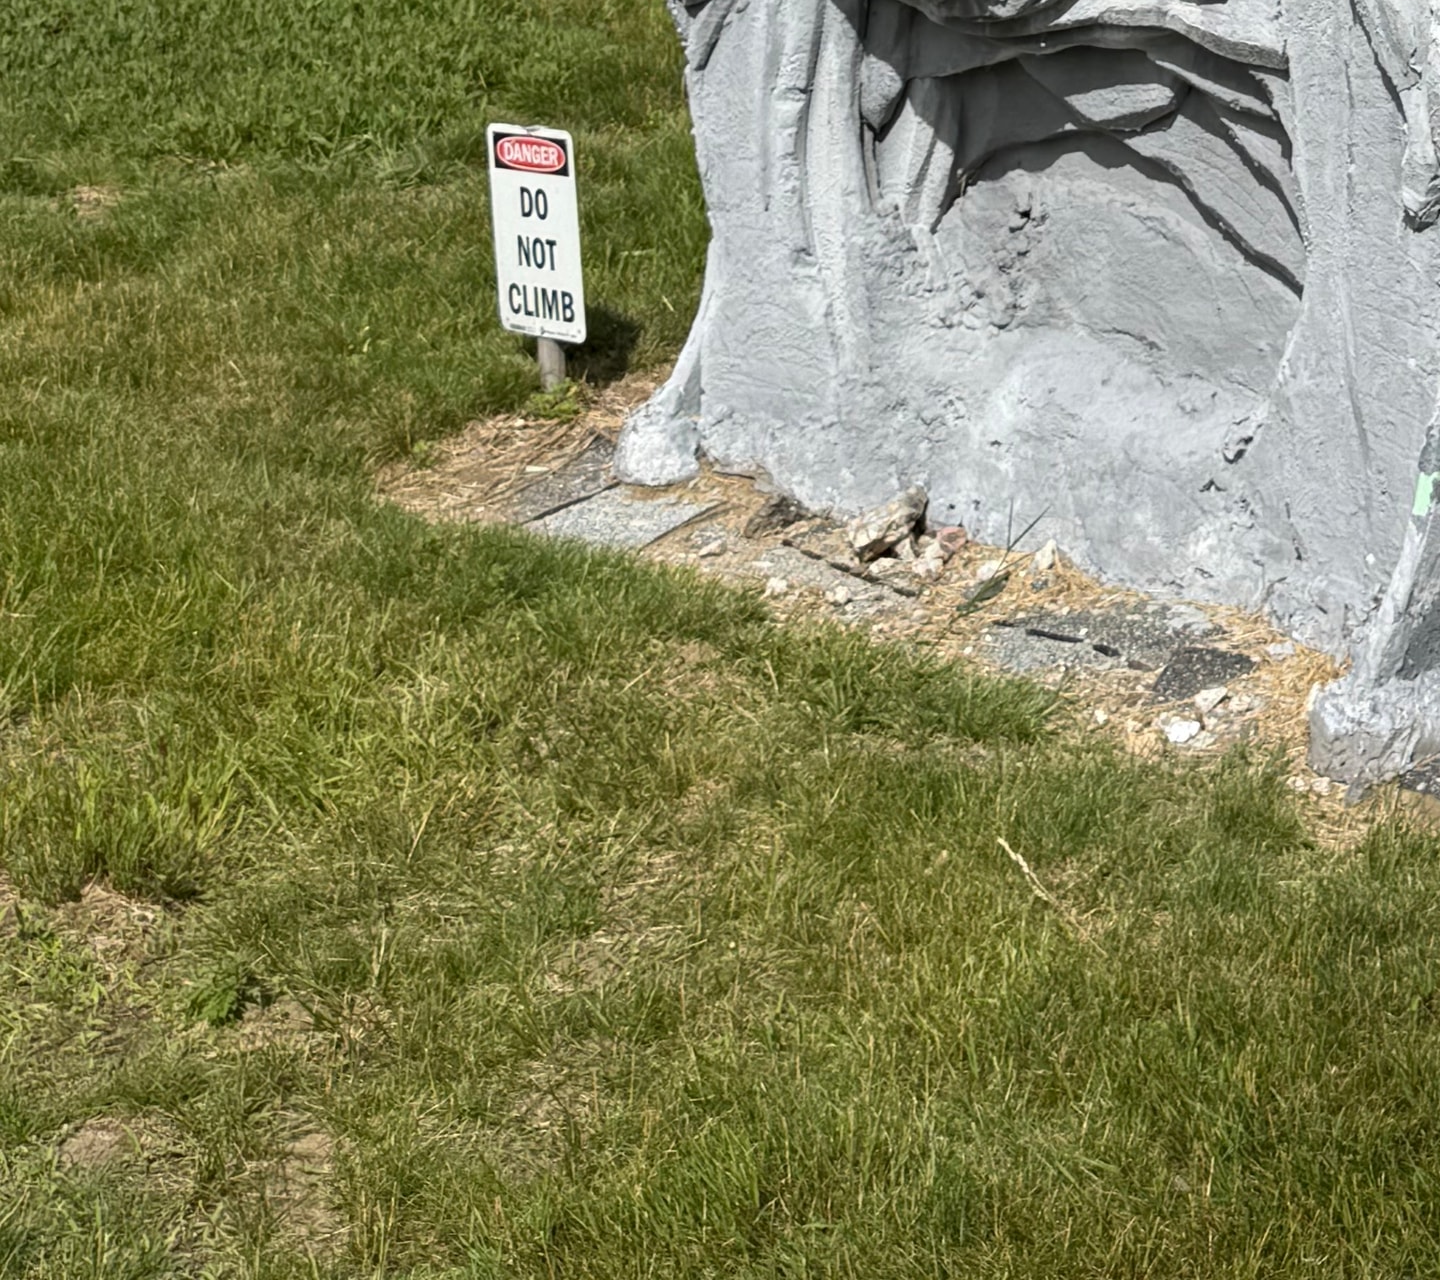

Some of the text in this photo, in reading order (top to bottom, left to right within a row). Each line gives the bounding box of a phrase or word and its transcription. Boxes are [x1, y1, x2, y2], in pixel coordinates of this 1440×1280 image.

[503, 140, 559, 167] DANGER
[520, 186, 548, 220] DO
[517, 235, 556, 271] NOT
[508, 283, 575, 323] CLIMB
